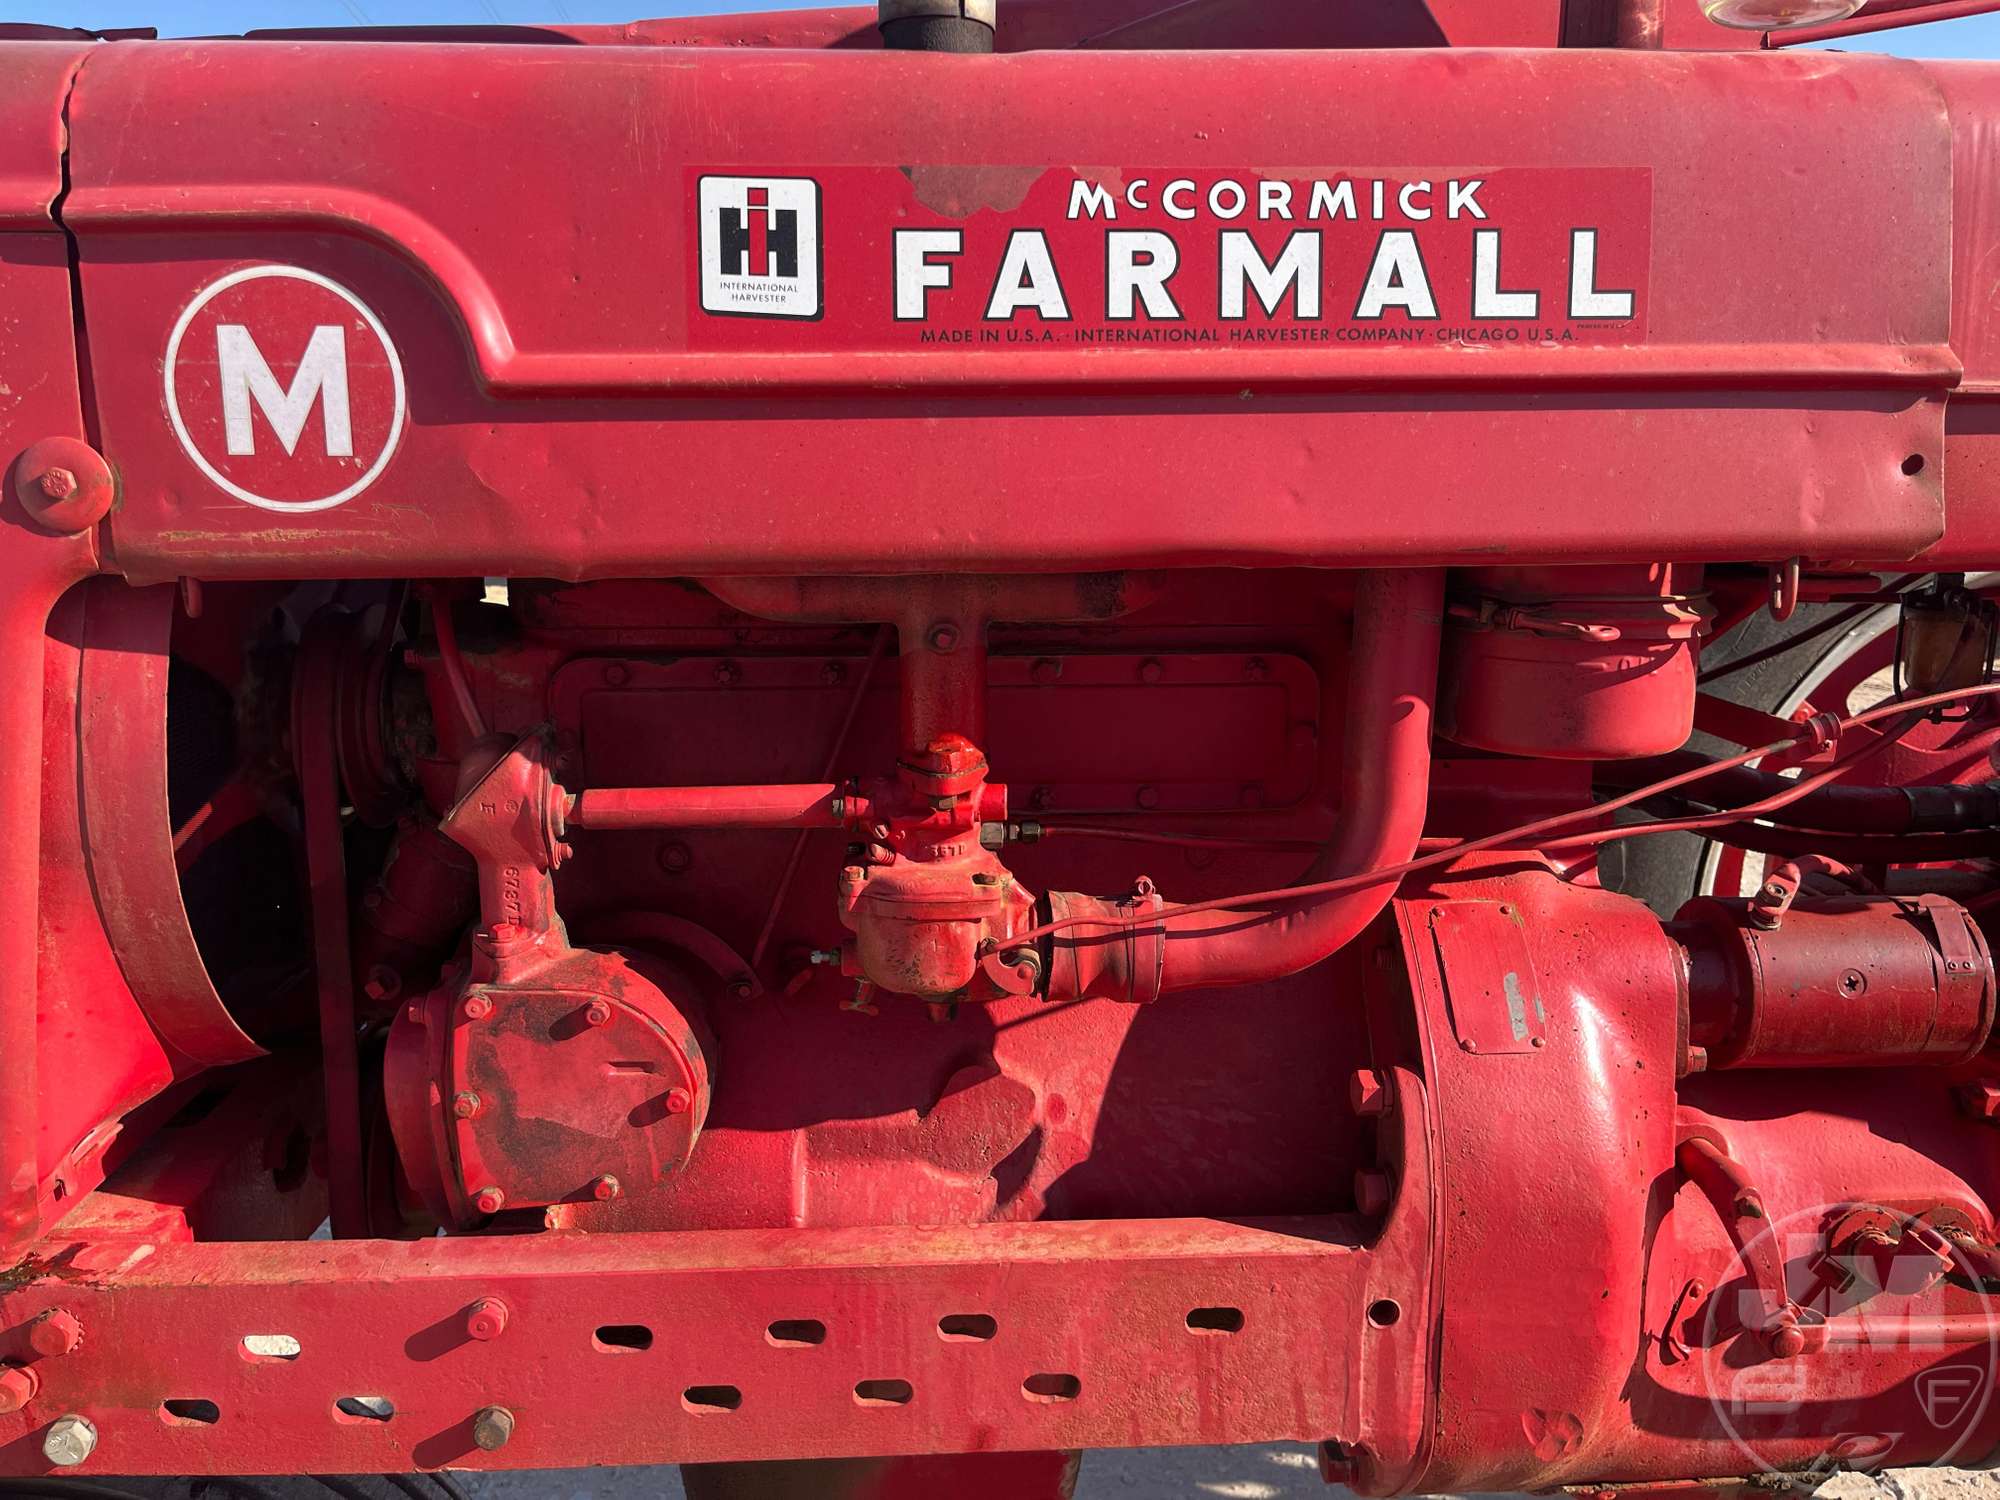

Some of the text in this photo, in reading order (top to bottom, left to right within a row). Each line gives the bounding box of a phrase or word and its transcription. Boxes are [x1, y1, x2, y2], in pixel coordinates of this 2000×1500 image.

[893, 228, 1636, 321] FARMALL
[720, 281, 798, 293] INTERNATIONAL
[731, 294, 787, 304] HARVESTER
[921, 329, 973, 343] MADE
[981, 329, 1000, 343] IN
[1006, 329, 1061, 344] U.S.A.
[1075, 328, 1219, 343] INTERNATIONAL
[1230, 327, 1329, 342] HARVESTER
[1337, 327, 1426, 342] COMPANY
[1436, 327, 1520, 341] CHICAGO
[1528, 327, 1579, 342] U.S.A.
[216, 324, 353, 457] M
